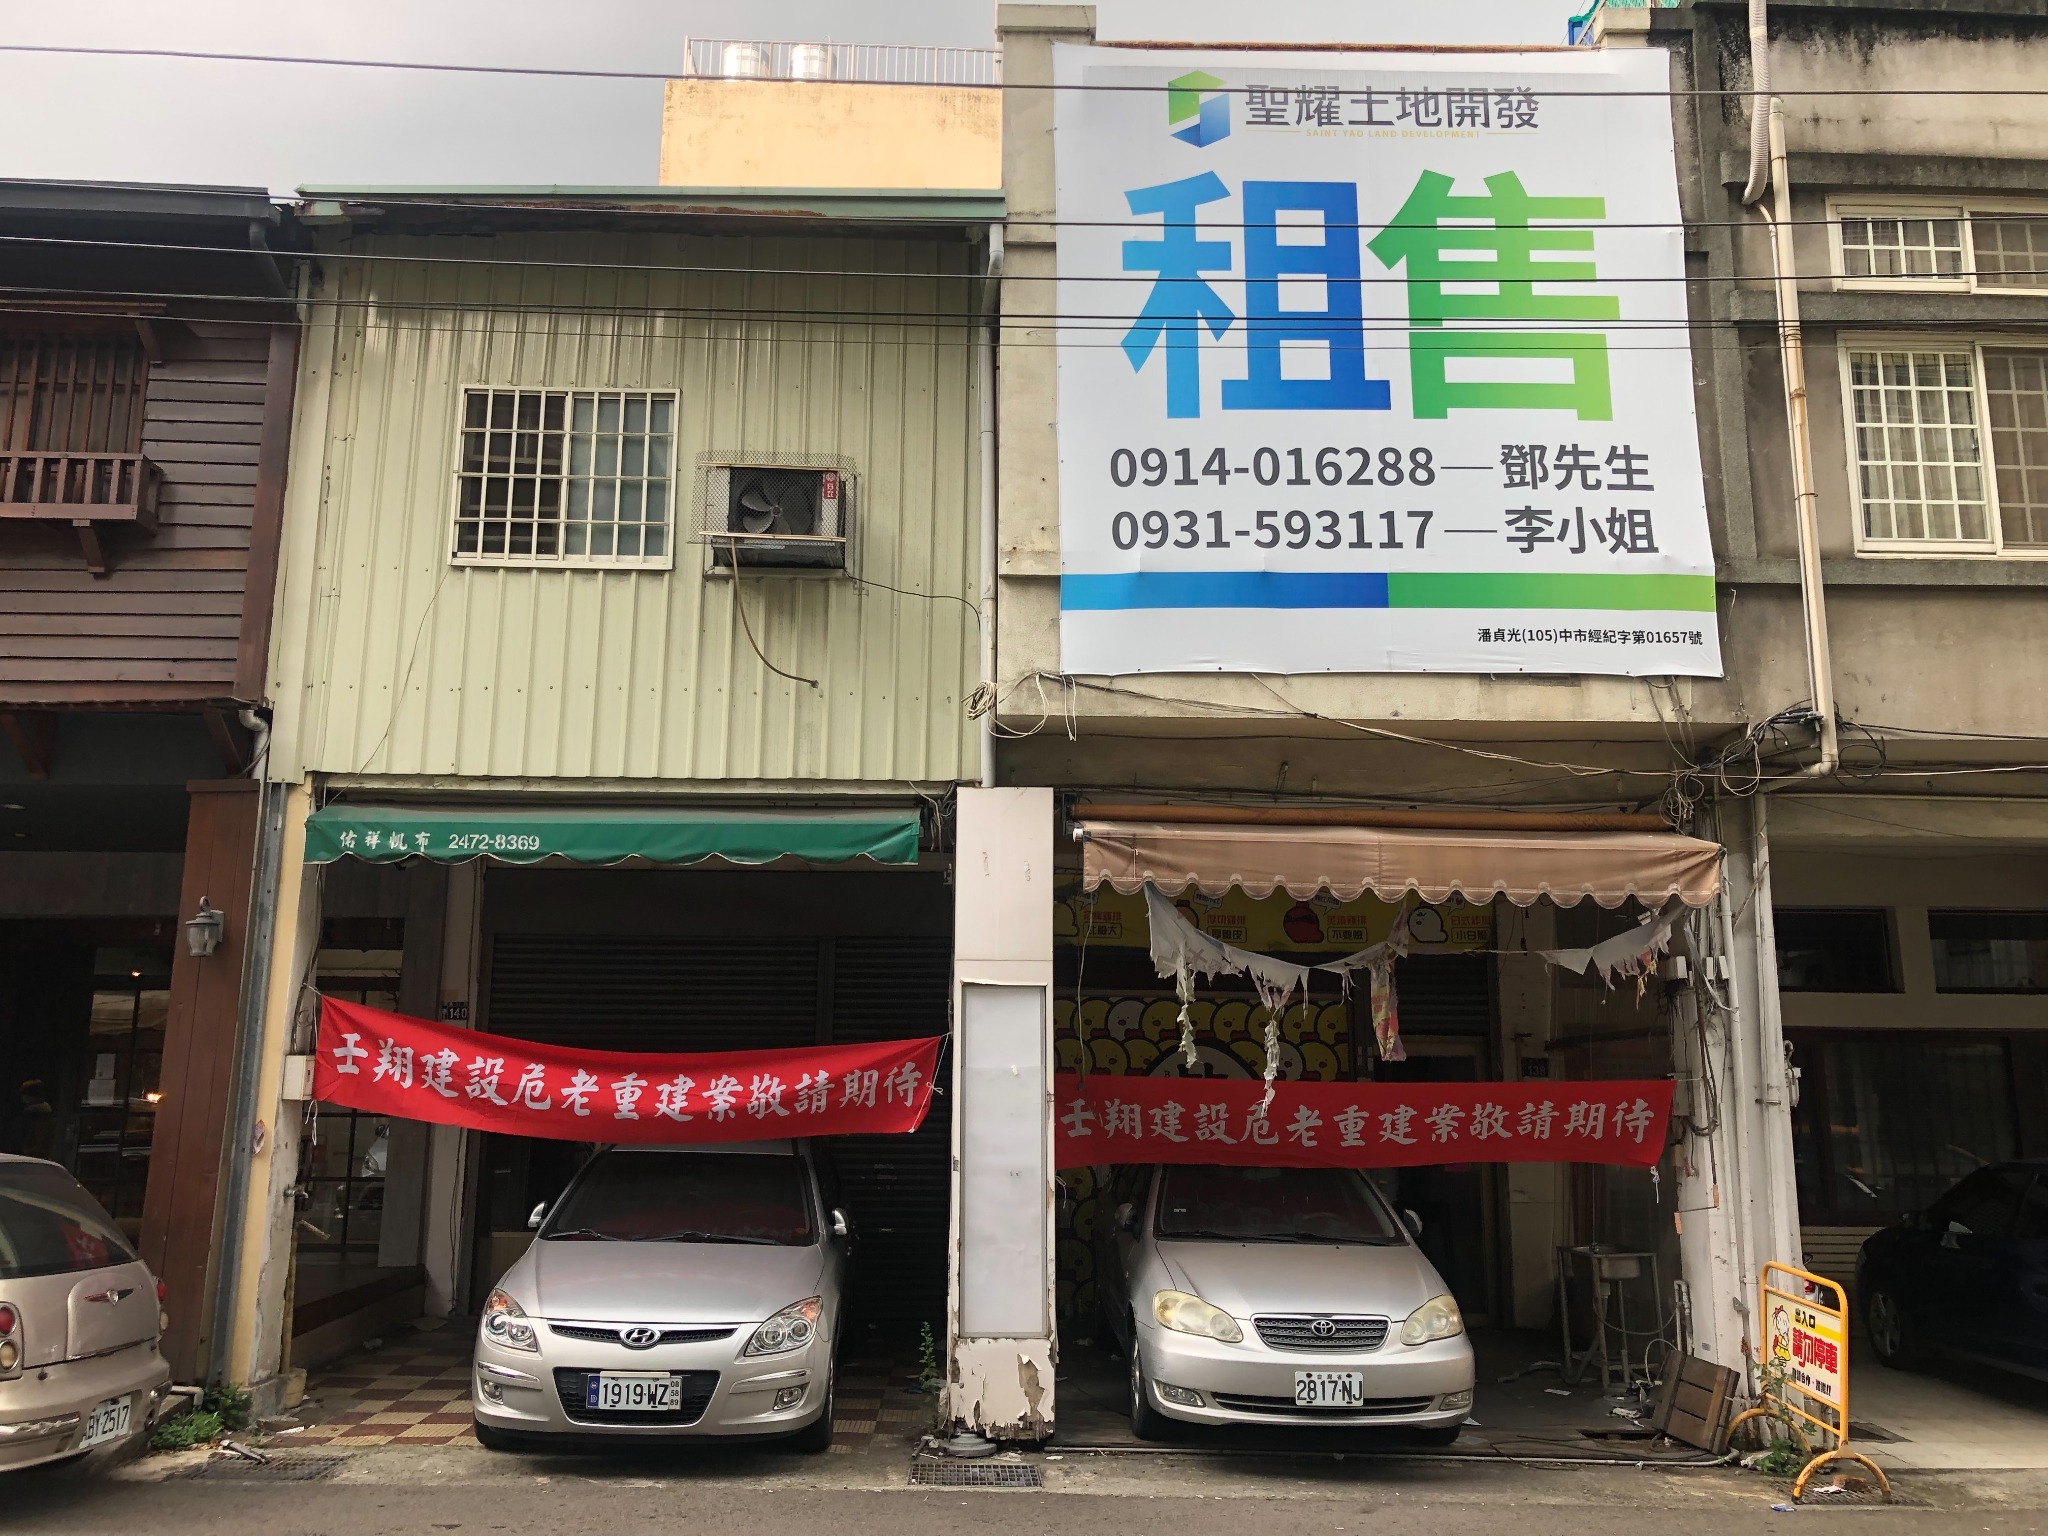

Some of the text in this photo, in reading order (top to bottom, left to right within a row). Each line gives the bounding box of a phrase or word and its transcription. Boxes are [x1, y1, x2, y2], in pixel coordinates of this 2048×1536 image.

[1245, 84, 1540, 129] 聖耀土地開發
[1306, 129, 1481, 139] SAINT YAO LAND DEVELOPMENT
[1121, 169, 1620, 421] 租售
[1477, 628, 1704, 645] 潘貞光(105)中市經紀字第01657號
[448, 834, 540, 850] 2472-8369
[449, 1007, 468, 1019] 140
[333, 1032, 923, 1124] 壬翔建設危老重建案敬請期待
[1061, 1098, 1654, 1148] 壬翔建設危老重建案敬請期待
[1794, 1308, 1816, 1329] 出入口
[1792, 1327, 1838, 1375] 請勿停車
